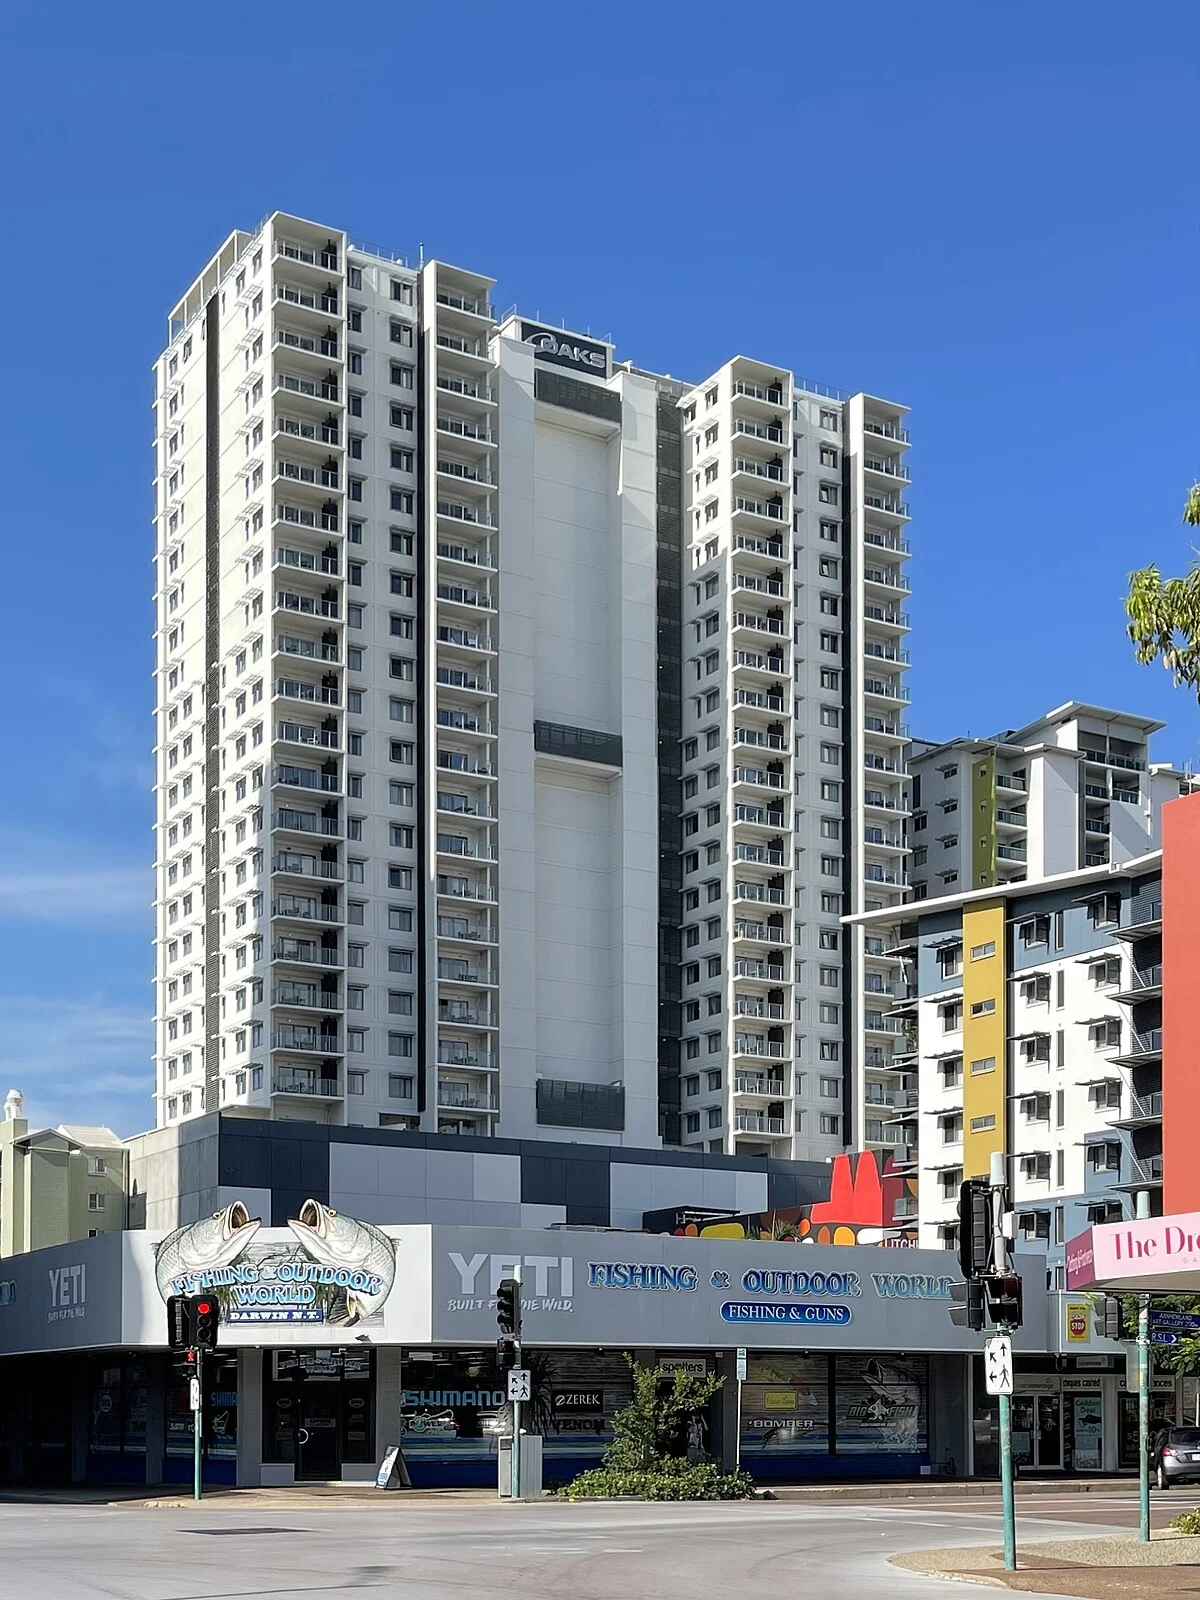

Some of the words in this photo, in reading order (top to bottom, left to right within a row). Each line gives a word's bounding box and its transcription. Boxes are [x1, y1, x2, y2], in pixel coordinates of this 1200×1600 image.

[533, 333, 605, 368] OAKS
[1110, 1231, 1157, 1260] The
[170, 1264, 260, 1296] FISHING
[277, 1263, 383, 1295] OUTDOOR
[448, 1252, 574, 1297] YETI
[588, 1262, 698, 1292] FISHING
[710, 1270, 730, 1288] &
[741, 1268, 862, 1297] OUTDOOR
[870, 1272, 958, 1301] WORLD
[49, 1264, 85, 1306] YETI
[234, 1284, 316, 1305] WORLD
[448, 1299, 484, 1311] BUILT
[520, 1300, 540, 1311] HE
[542, 1299, 574, 1312] WILD.
[728, 1304, 786, 1319] FISHING
[789, 1307, 801, 1320] &
[805, 1307, 844, 1321] GUNS
[230, 1311, 288, 1320] DARWIN
[291, 1311, 320, 1320] N.T.
[1071, 1322, 1085, 1330] STOP
[404, 1390, 506, 1407] SHIMANO
[565, 1394, 600, 1405] ZEREK
[848, 1406, 868, 1417] BIG
[888, 1406, 914, 1417] FISH
[753, 1420, 814, 1428] BOMBER
